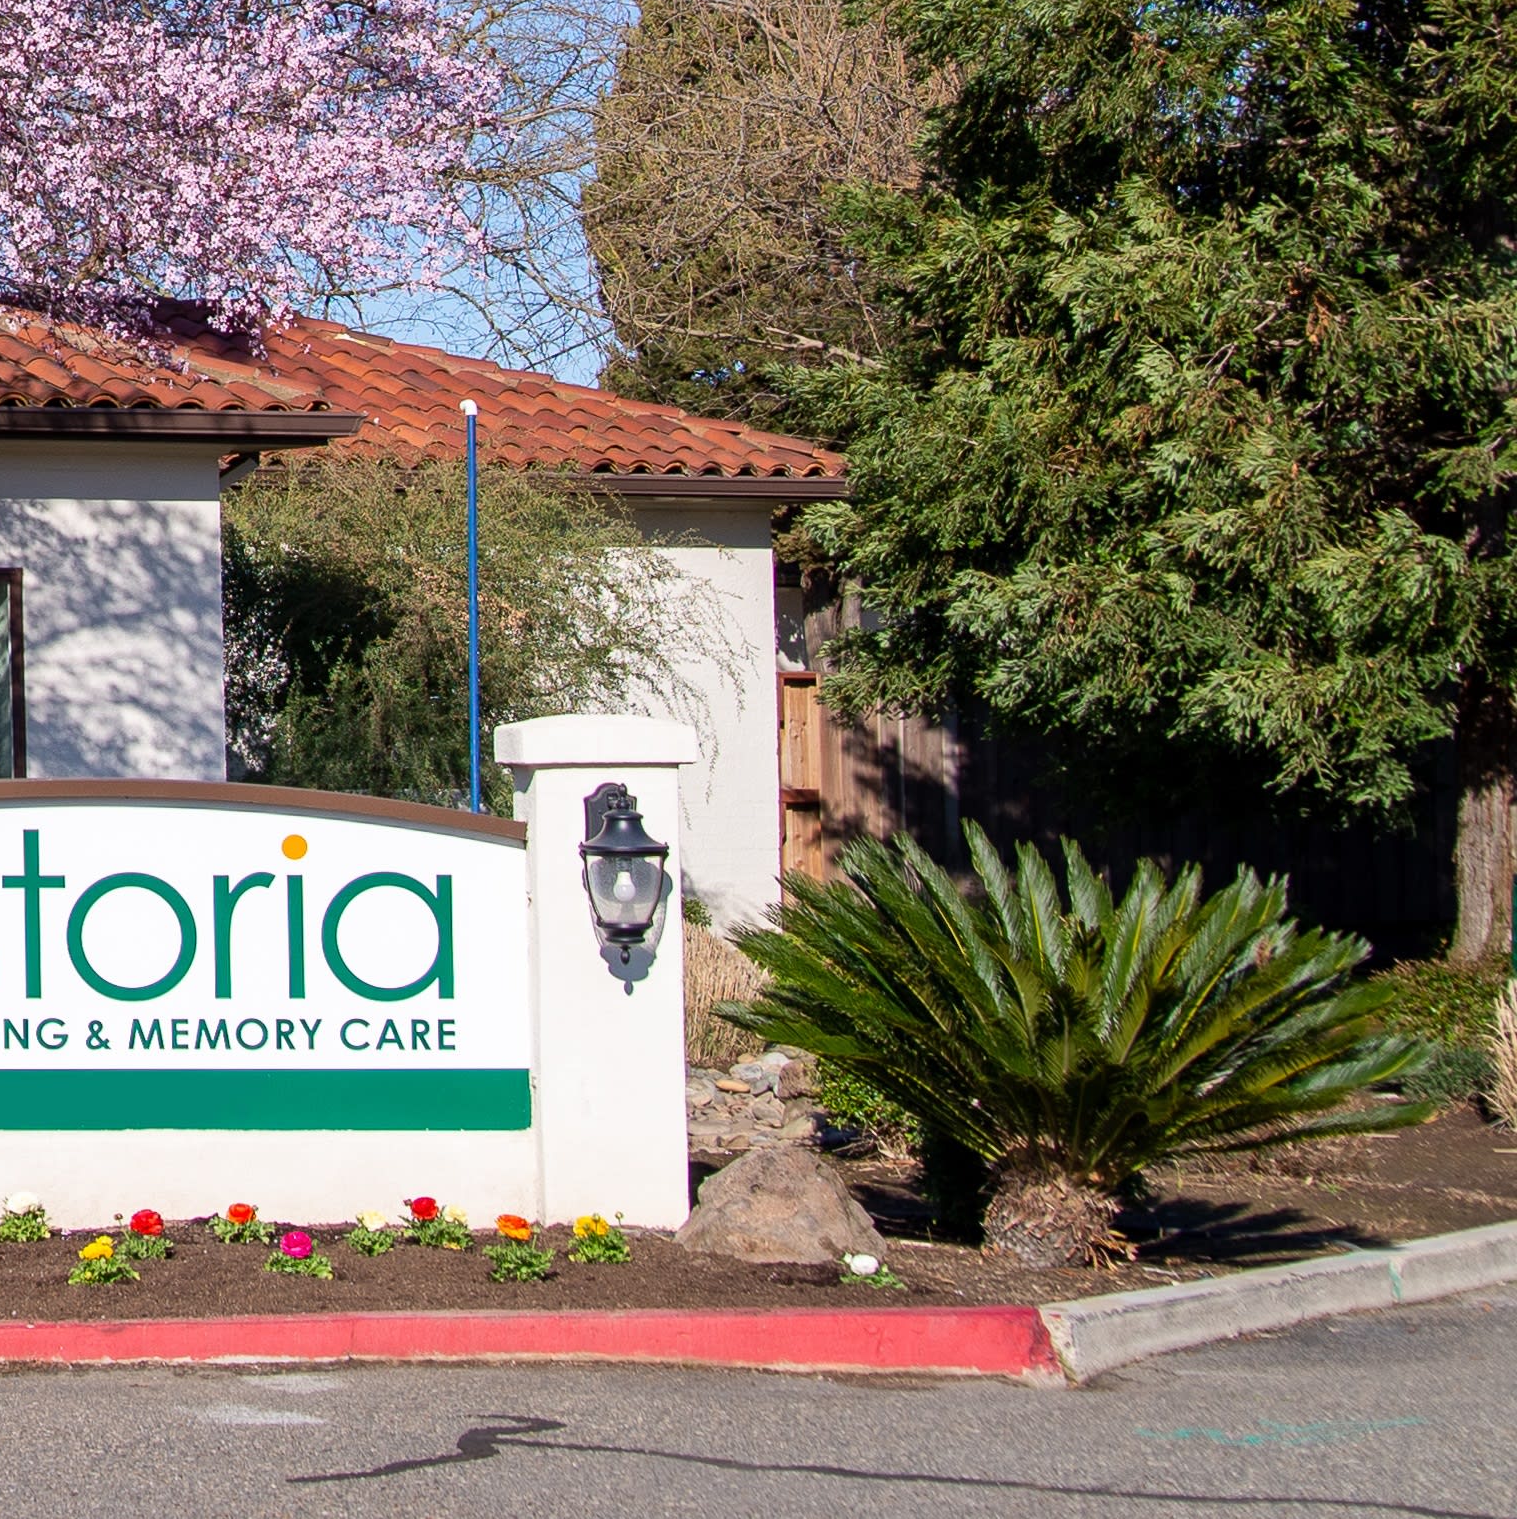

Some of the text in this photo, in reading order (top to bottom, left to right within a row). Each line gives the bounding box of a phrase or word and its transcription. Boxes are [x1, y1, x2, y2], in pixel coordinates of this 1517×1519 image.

[85, 1018, 111, 1050] &
[128, 1017, 322, 1050] MEMORY
[340, 1017, 456, 1050] CARE
